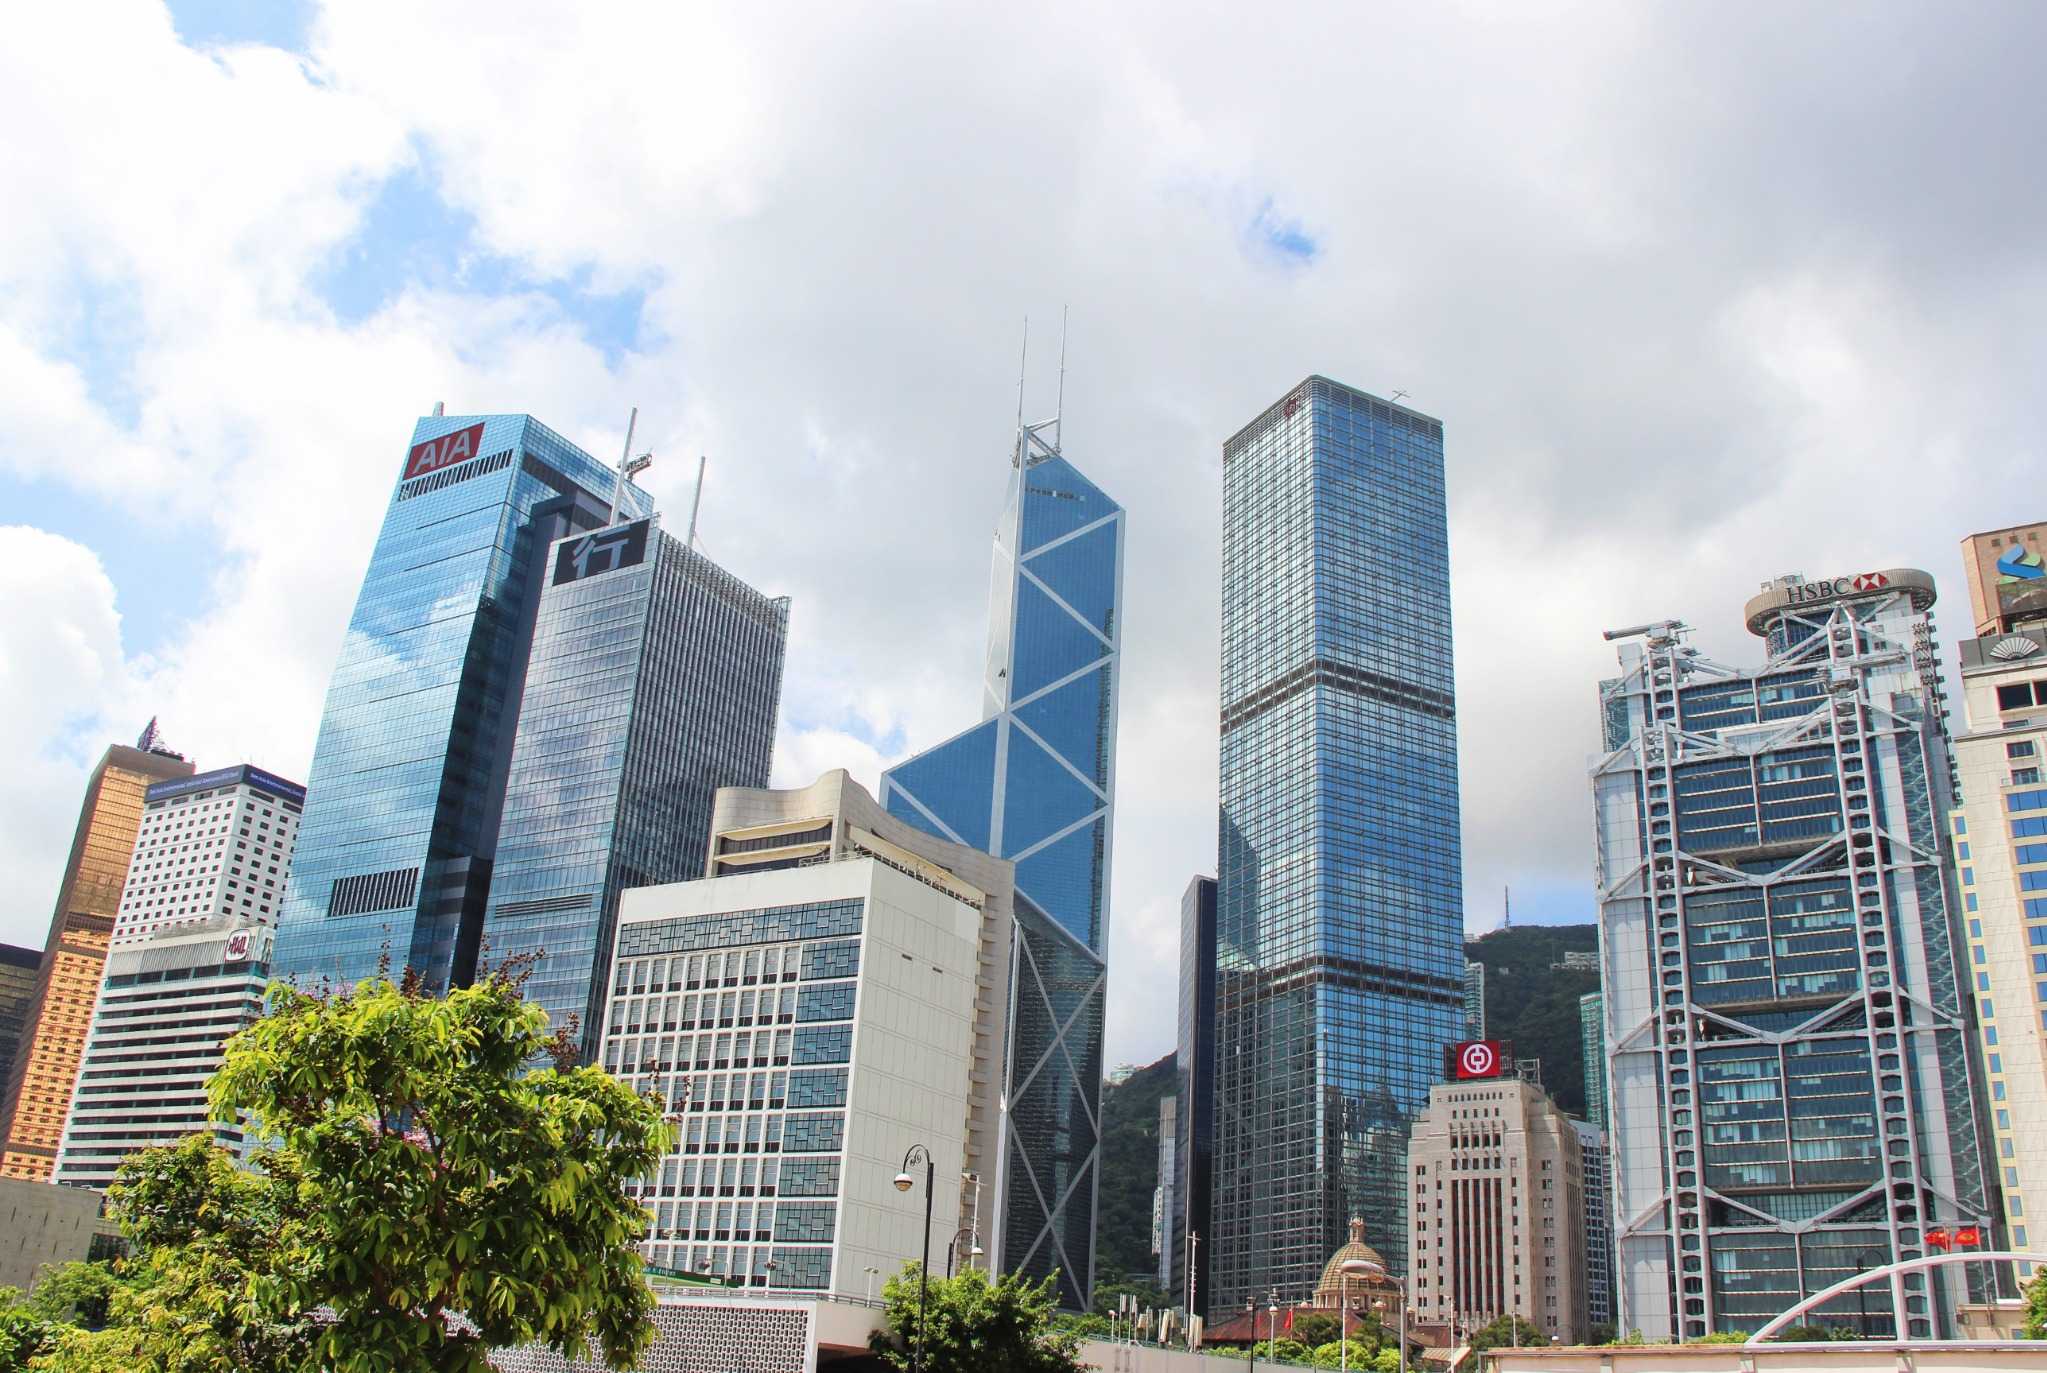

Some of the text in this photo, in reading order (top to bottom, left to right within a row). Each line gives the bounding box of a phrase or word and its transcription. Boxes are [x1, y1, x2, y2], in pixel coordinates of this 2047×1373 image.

[412, 431, 471, 474] AIA
[571, 524, 630, 580] 行
[1785, 578, 1849, 604] HSBC
